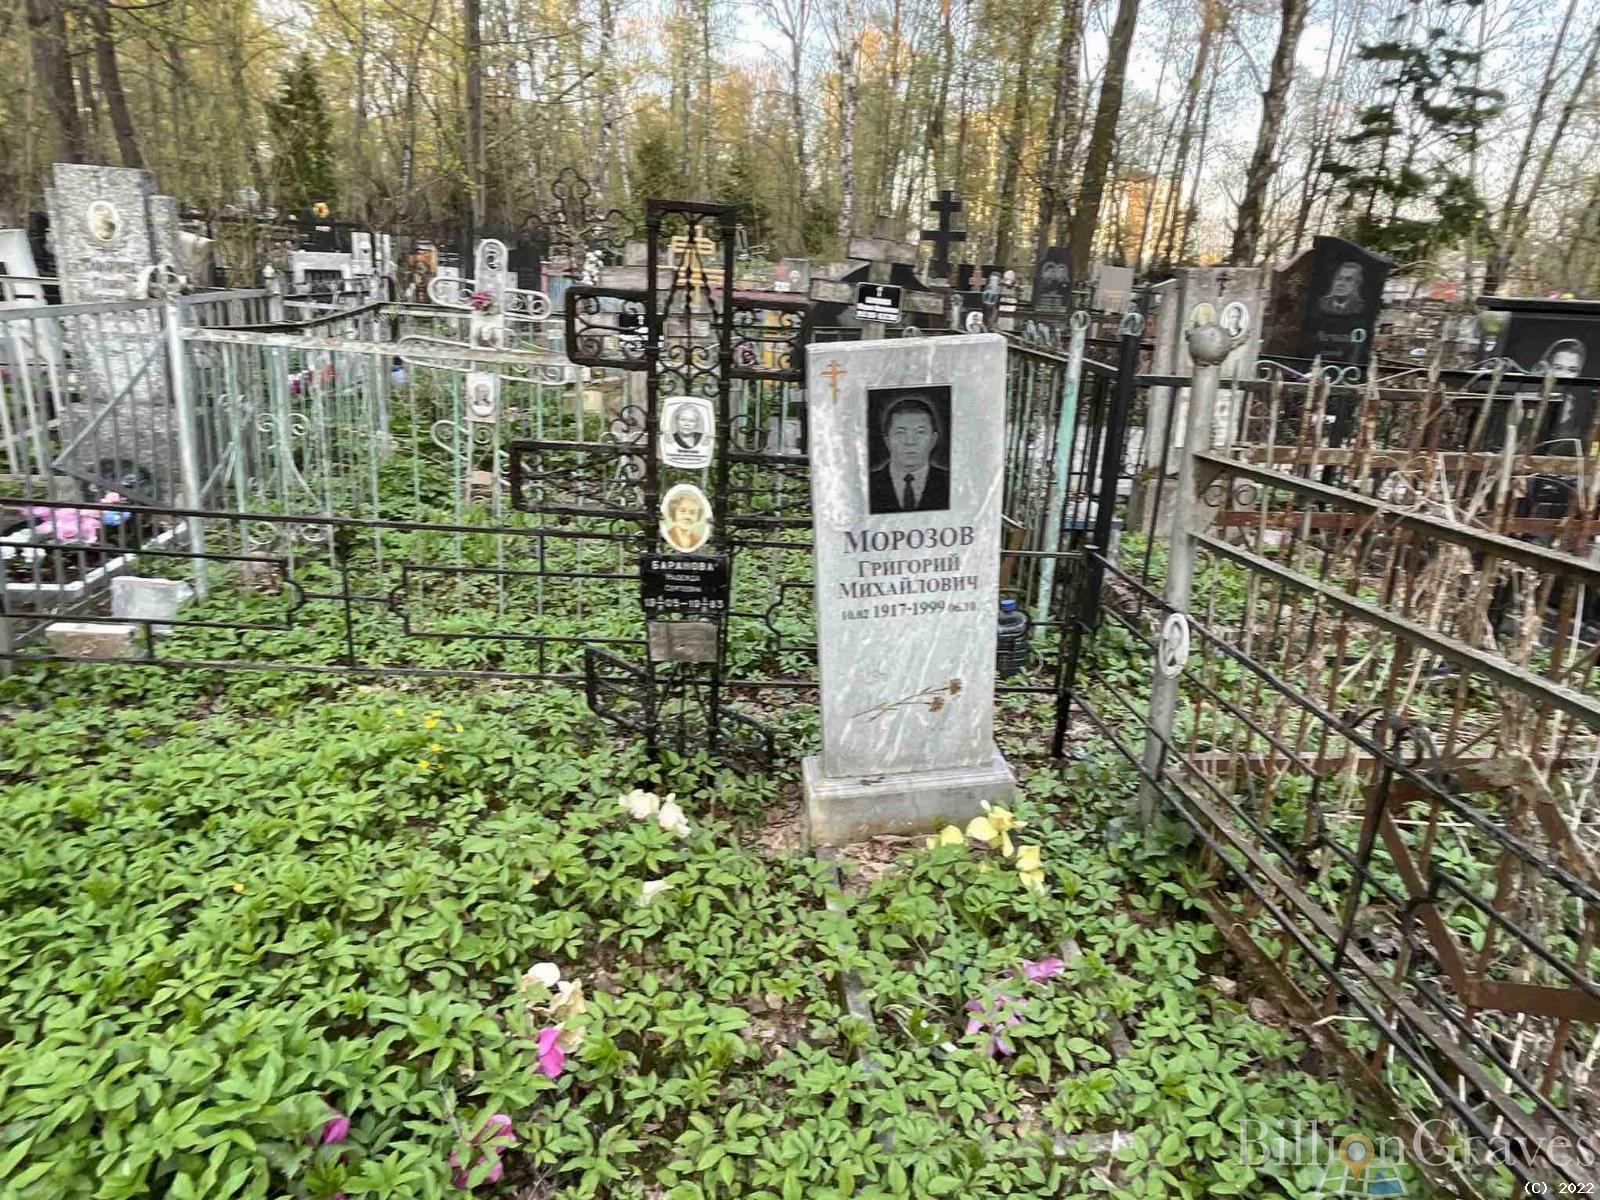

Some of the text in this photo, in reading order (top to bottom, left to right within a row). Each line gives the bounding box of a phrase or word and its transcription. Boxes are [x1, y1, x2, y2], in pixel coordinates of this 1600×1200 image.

[843, 526, 975, 554] МОРОЗОВ
[858, 553, 961, 578] ГРИГОРИЙ
[839, 575, 978, 600] МИХАЙЛОВИЧ
